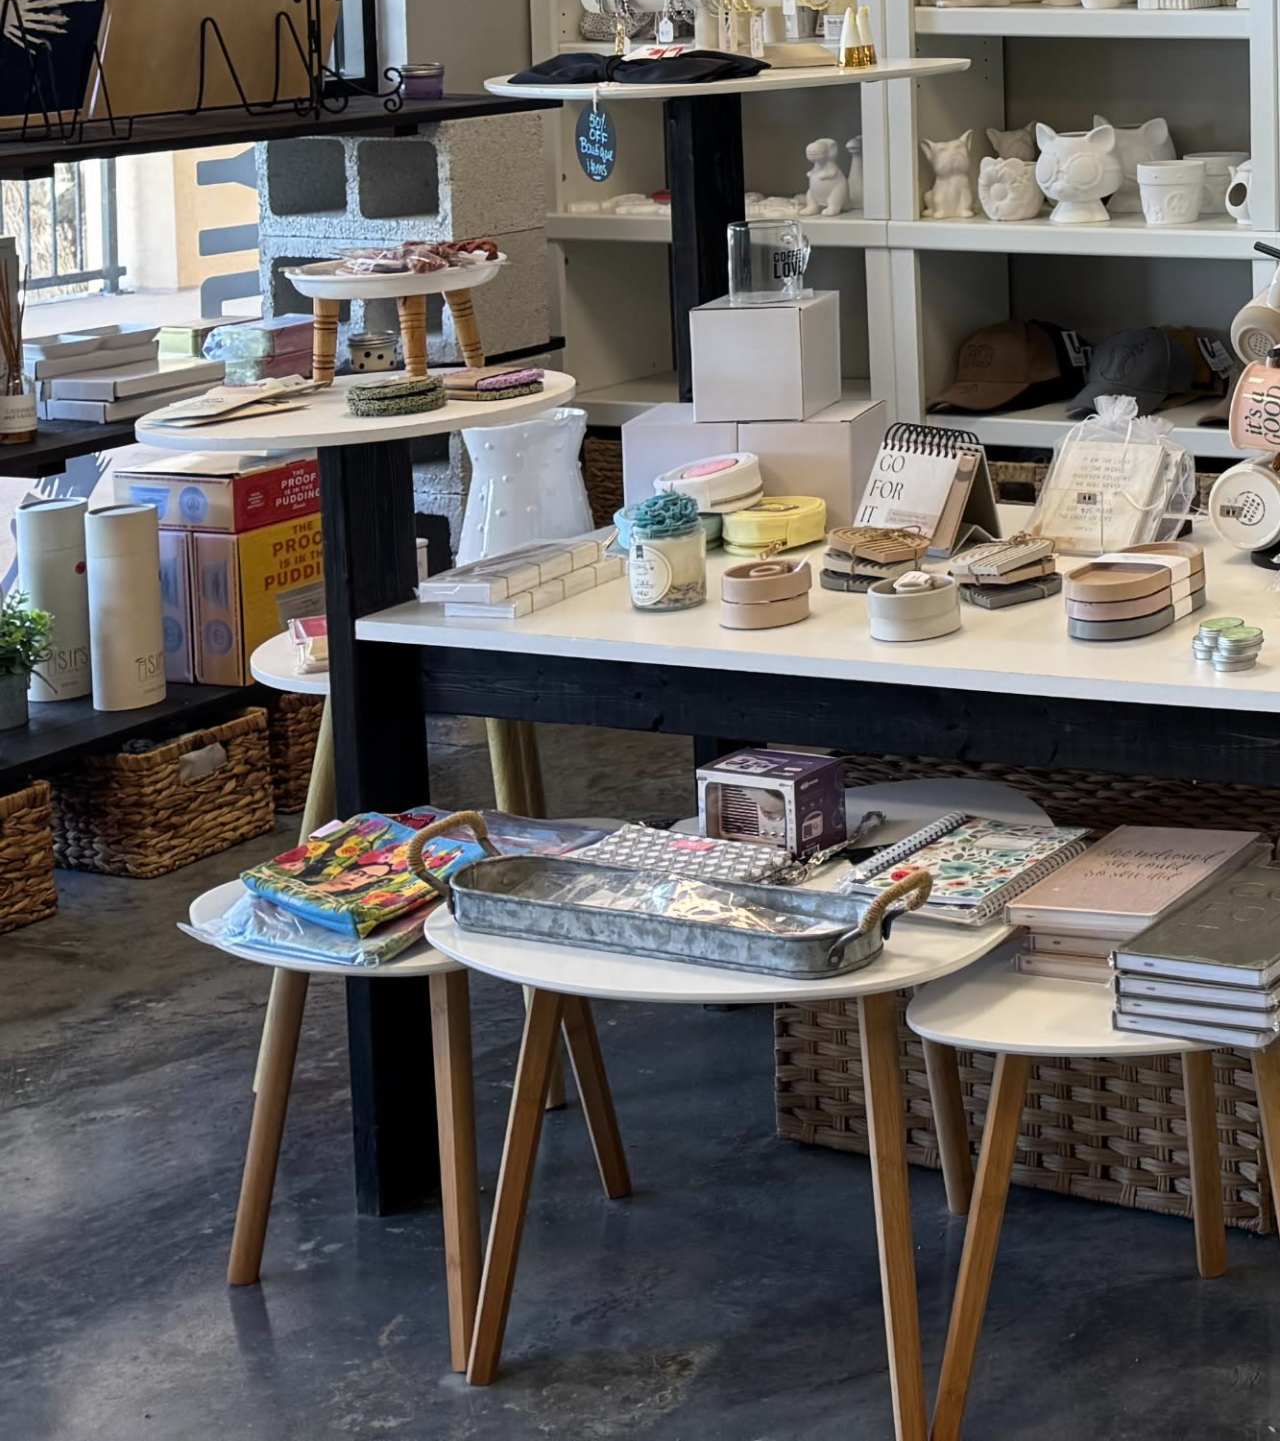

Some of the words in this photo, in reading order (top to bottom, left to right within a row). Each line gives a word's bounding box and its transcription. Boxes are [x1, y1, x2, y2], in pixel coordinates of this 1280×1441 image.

[589, 128, 608, 144] OFF
[880, 454, 906, 473] GO
[281, 472, 317, 489] PROOF
[869, 479, 904, 501] FOR
[860, 504, 880, 523] IT
[292, 520, 313, 535] THE
[279, 558, 291, 570] IS
[294, 554, 306, 566] IN
